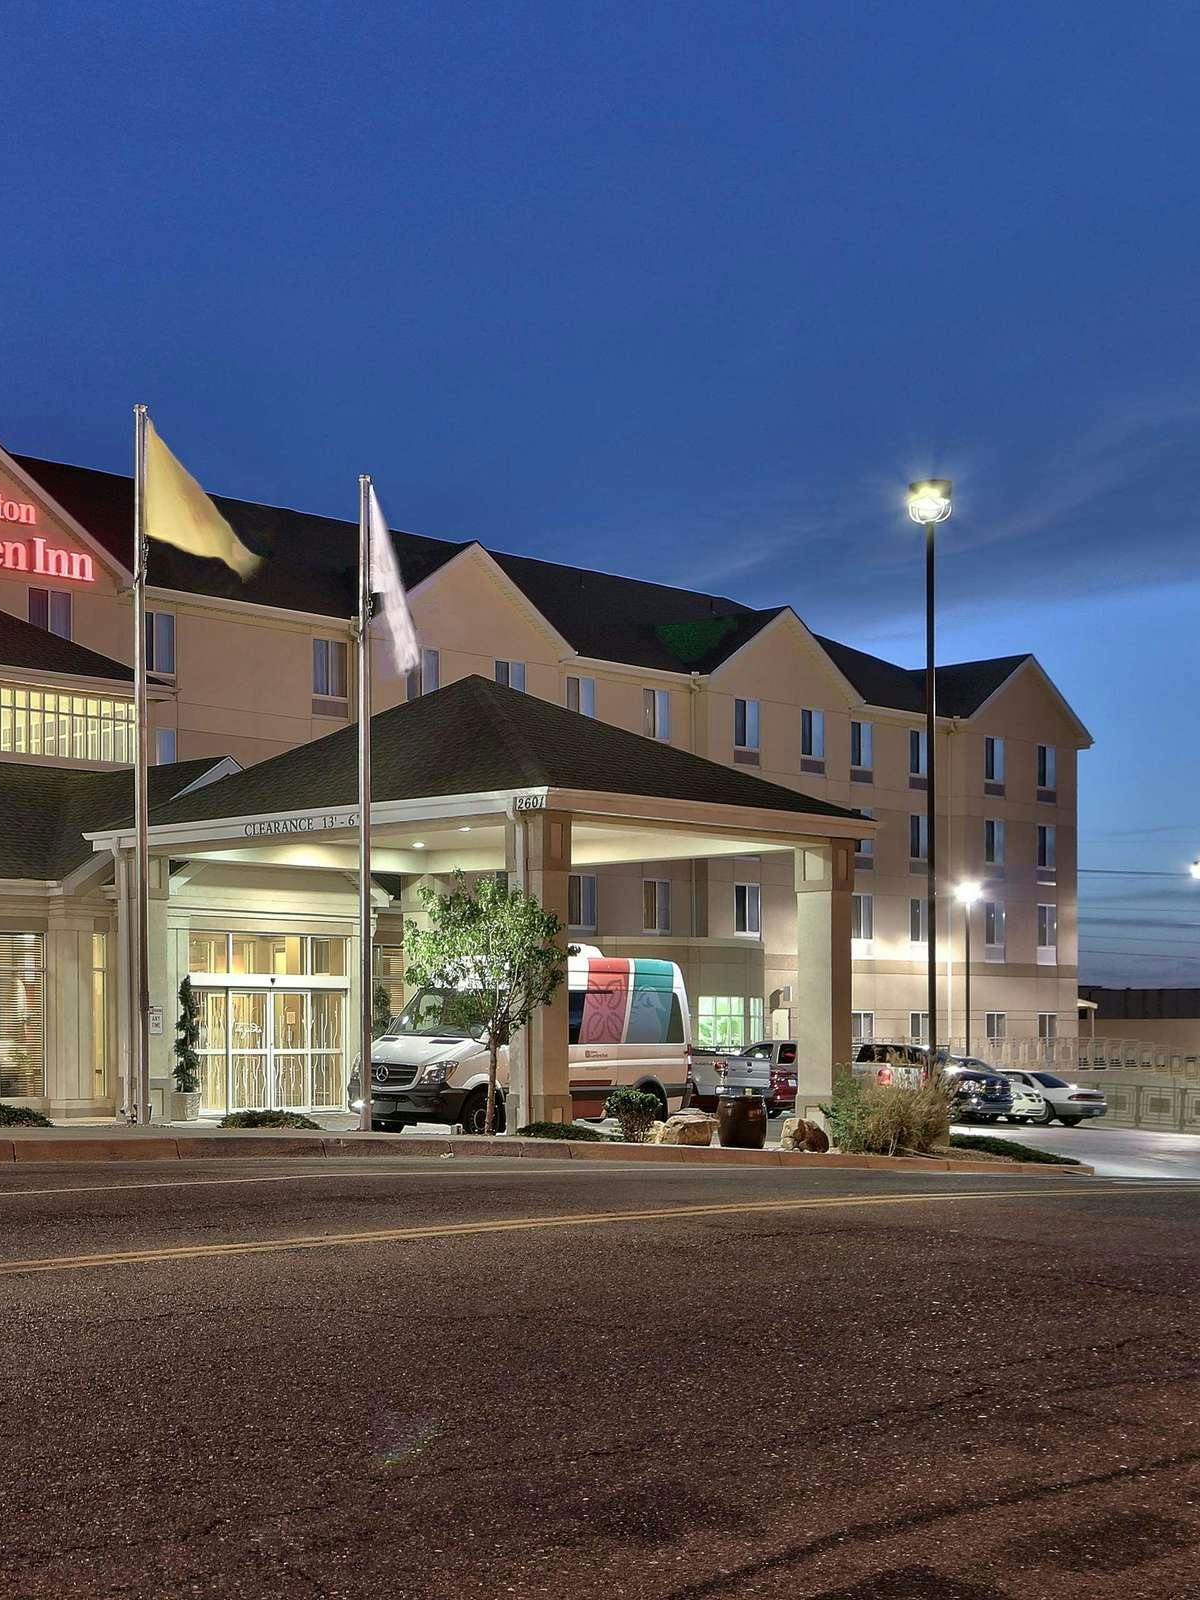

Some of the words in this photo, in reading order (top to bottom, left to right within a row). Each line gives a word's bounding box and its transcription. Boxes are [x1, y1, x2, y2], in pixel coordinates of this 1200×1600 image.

[32, 537, 95, 582] Inn
[517, 796, 544, 810] 2601
[244, 818, 314, 836] CLEARANCE
[322, 816, 337, 829] 13'
